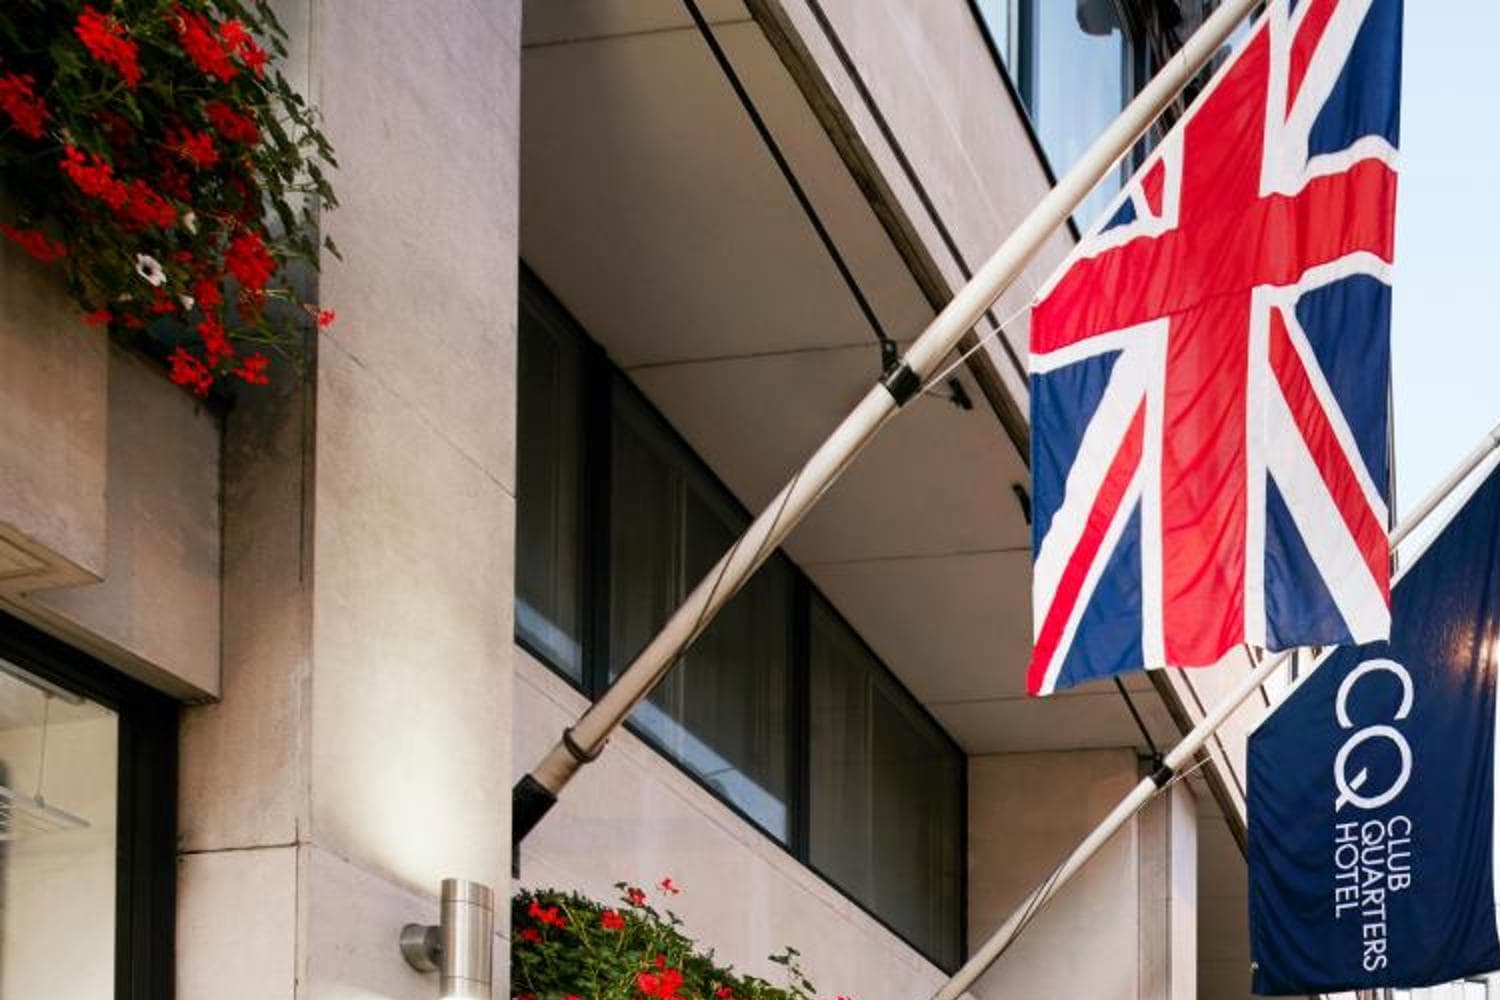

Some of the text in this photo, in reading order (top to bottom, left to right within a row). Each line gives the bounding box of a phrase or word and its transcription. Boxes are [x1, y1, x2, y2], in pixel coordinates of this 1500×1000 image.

[1334, 658, 1414, 813] CQ
[1335, 821, 1359, 919] HOTEL
[1361, 820, 1387, 972] QUARTERS
[1387, 815, 1412, 891] CLUB
